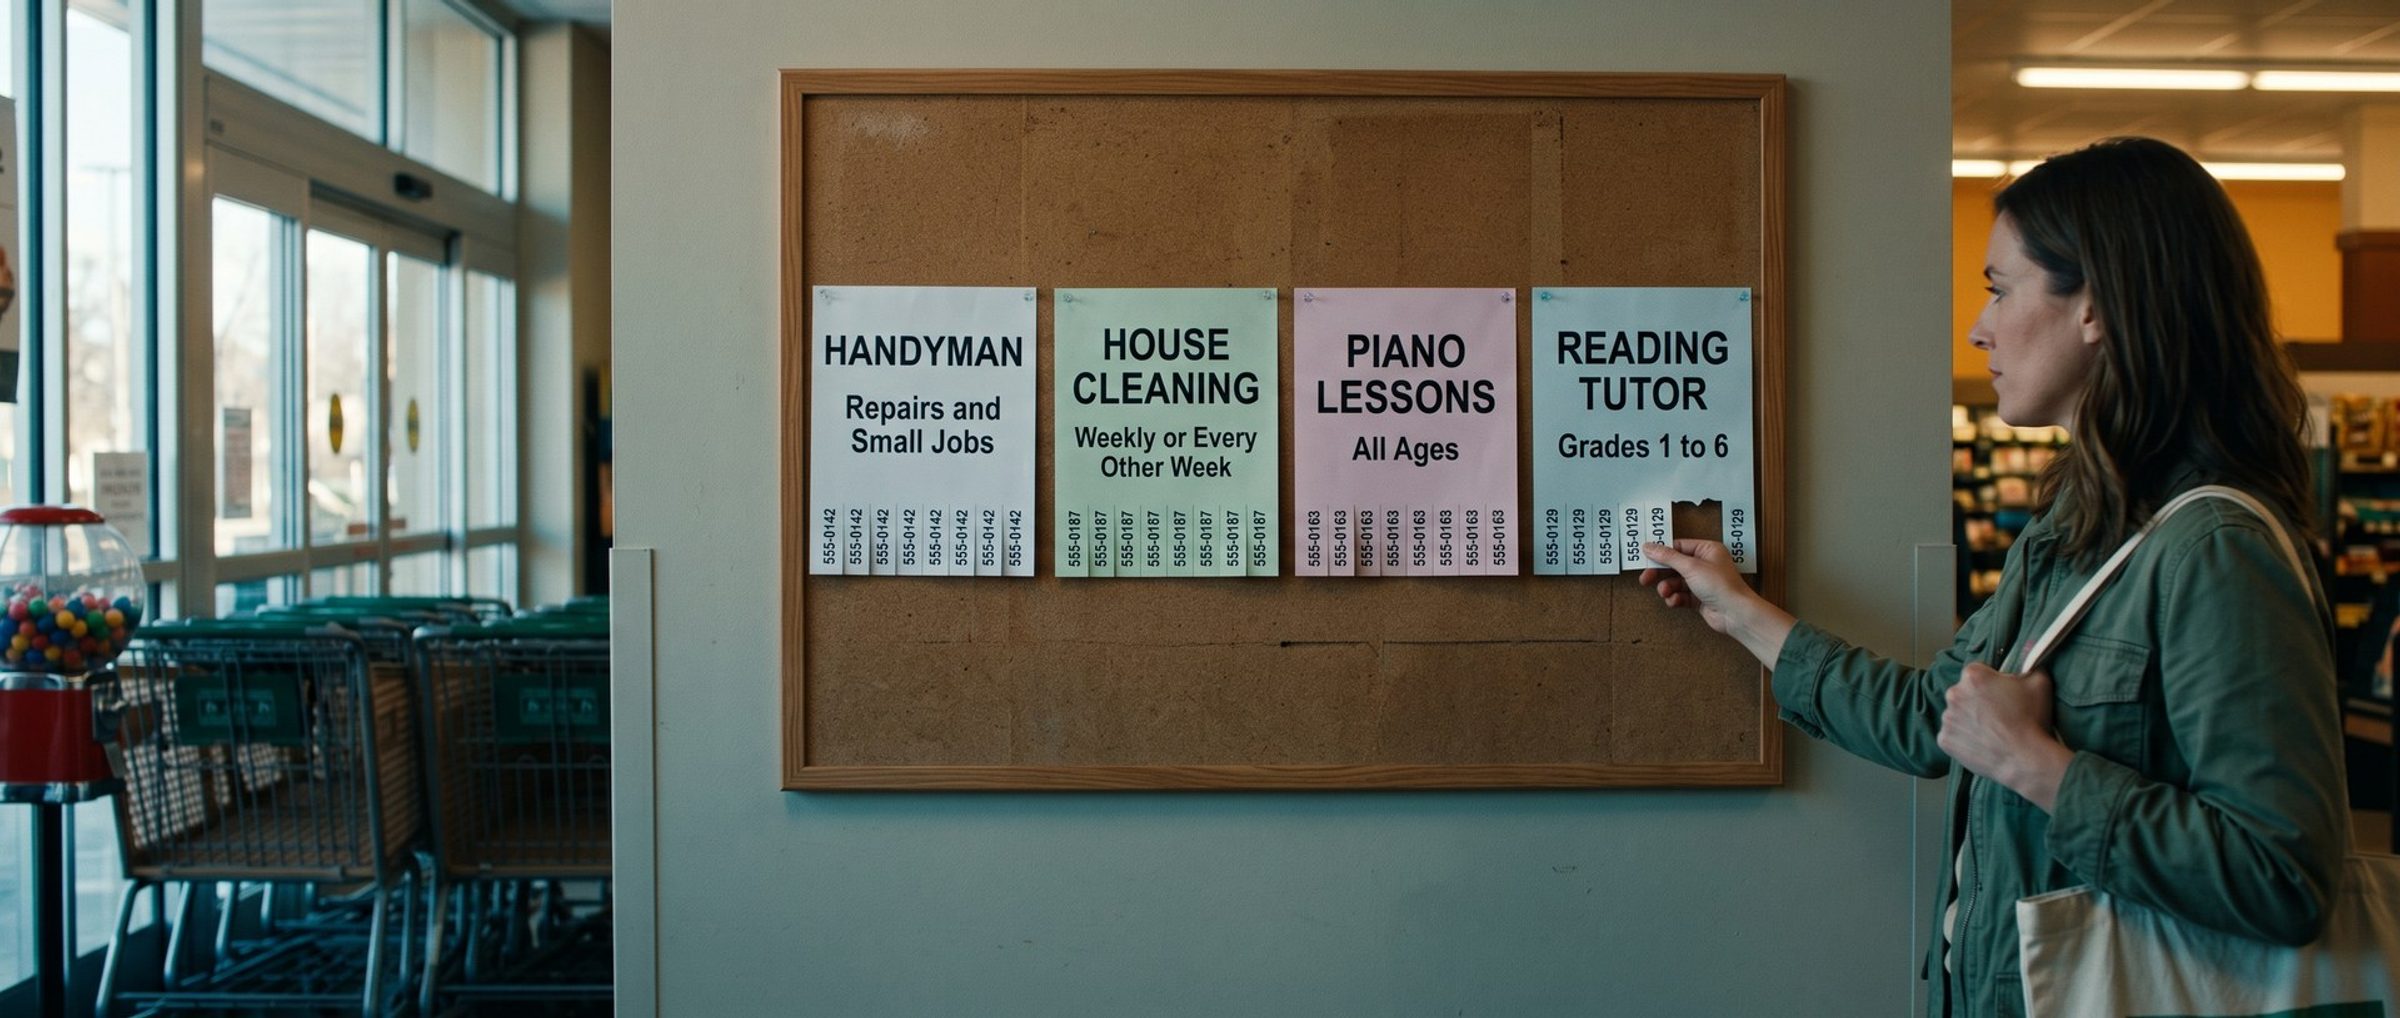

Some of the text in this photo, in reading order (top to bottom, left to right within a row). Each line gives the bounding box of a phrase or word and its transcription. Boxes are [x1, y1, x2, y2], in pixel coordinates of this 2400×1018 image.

[826, 335, 1022, 366] HANDYMAN
[1105, 328, 1229, 361] HOUSE
[1348, 334, 1465, 368] PIANO
[1559, 331, 1728, 365] READING
[847, 395, 1000, 425] Repairs and
[1074, 372, 1258, 404] CLEANING
[1318, 380, 1495, 414] LESSONS
[1579, 377, 1707, 410] TUTOR
[852, 428, 994, 453] Small Jobs
[1075, 427, 1257, 453] Weekly or Every
[1101, 456, 1231, 477] Other Week
[1352, 437, 1458, 467] All Ages
[1559, 433, 1728, 458] Grades 1 to 6
[822, 509, 836, 565] 555-0142
[849, 509, 863, 565] 555-0142
[875, 509, 890, 566] 555-0142
[902, 510, 916, 566] 555-0142
[928, 510, 942, 566] 555-0142
[955, 510, 969, 566] 555-0142
[981, 510, 995, 567] 555-0142
[1008, 511, 1022, 567] 555-0142
[1068, 511, 1081, 567] 555-0187
[1094, 511, 1108, 567] 555-0187
[1120, 511, 1134, 567] 555-0187
[1147, 511, 1160, 567] 555-0187
[1173, 511, 1187, 567] 555-0187
[1199, 511, 1213, 567] 555-0187
[1226, 511, 1240, 567] 555-0187
[1253, 511, 1267, 567] 555-0187
[1307, 511, 1321, 567] 555-0163
[1334, 511, 1347, 567] 555-0163
[1359, 511, 1374, 567] 555-0163
[1386, 511, 1400, 567] 555-0163
[1413, 510, 1426, 567] 555-0163
[1439, 510, 1453, 567] 555-0163
[1465, 510, 1479, 566] 555-0163
[1492, 510, 1506, 566] 555-0163
[1545, 509, 1559, 566] 555-0129
[1572, 509, 1586, 565] 555-0129
[1598, 509, 1613, 565] 555-0129
[1625, 509, 1640, 562] 555-0129
[1730, 508, 1744, 563] 555-0129
